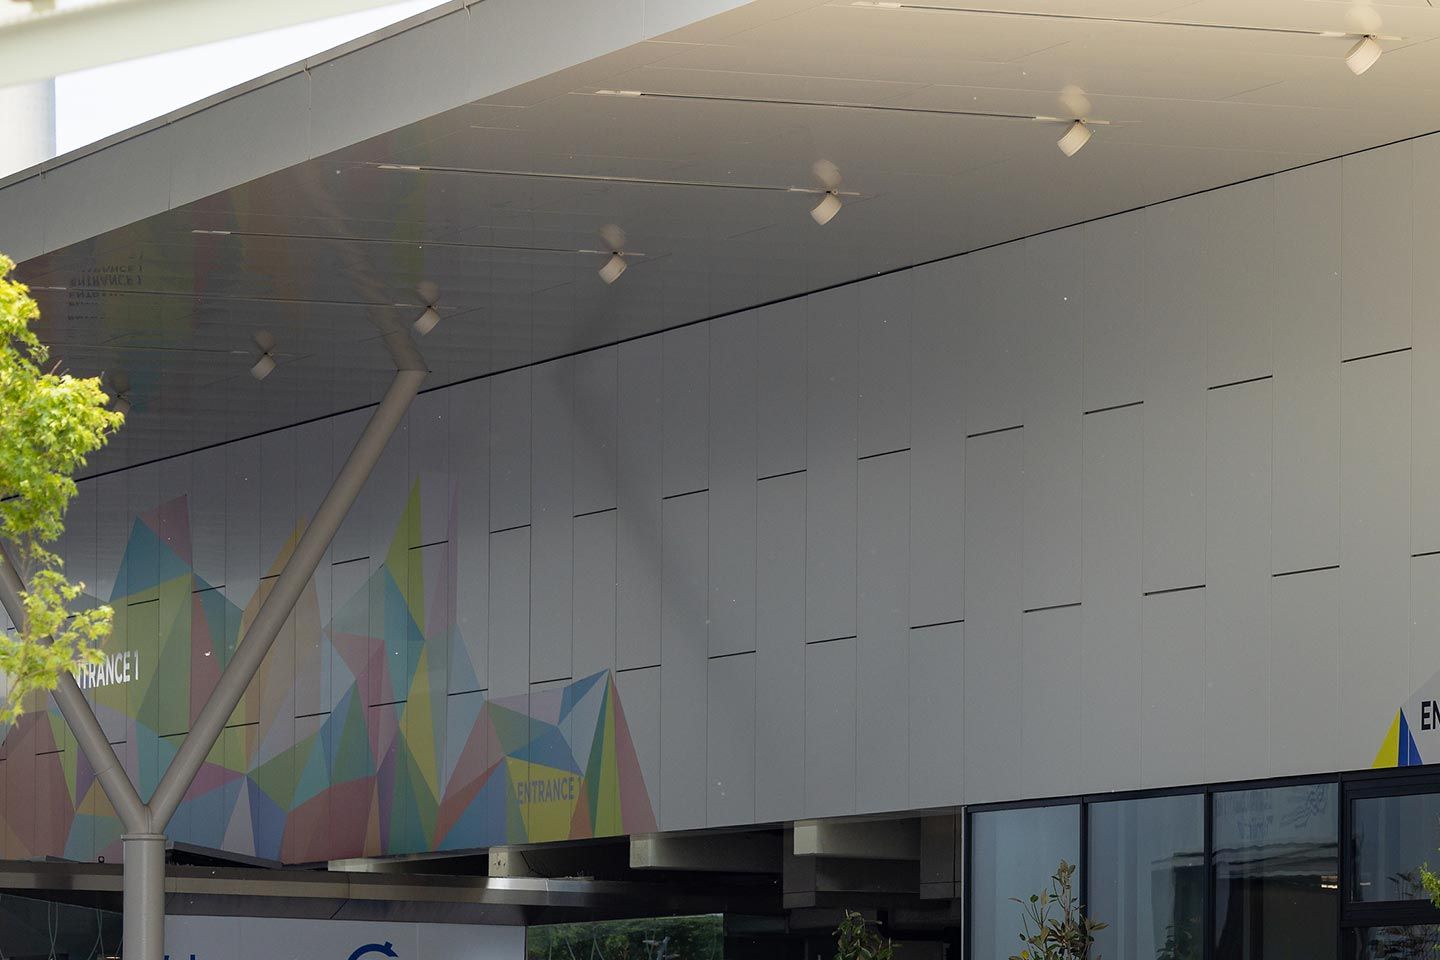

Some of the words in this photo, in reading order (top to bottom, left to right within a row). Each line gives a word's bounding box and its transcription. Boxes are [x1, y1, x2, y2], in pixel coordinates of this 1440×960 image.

[73, 651, 131, 689] NTRANCE
[134, 650, 139, 680] 1
[517, 776, 577, 804] ENTRANCE
